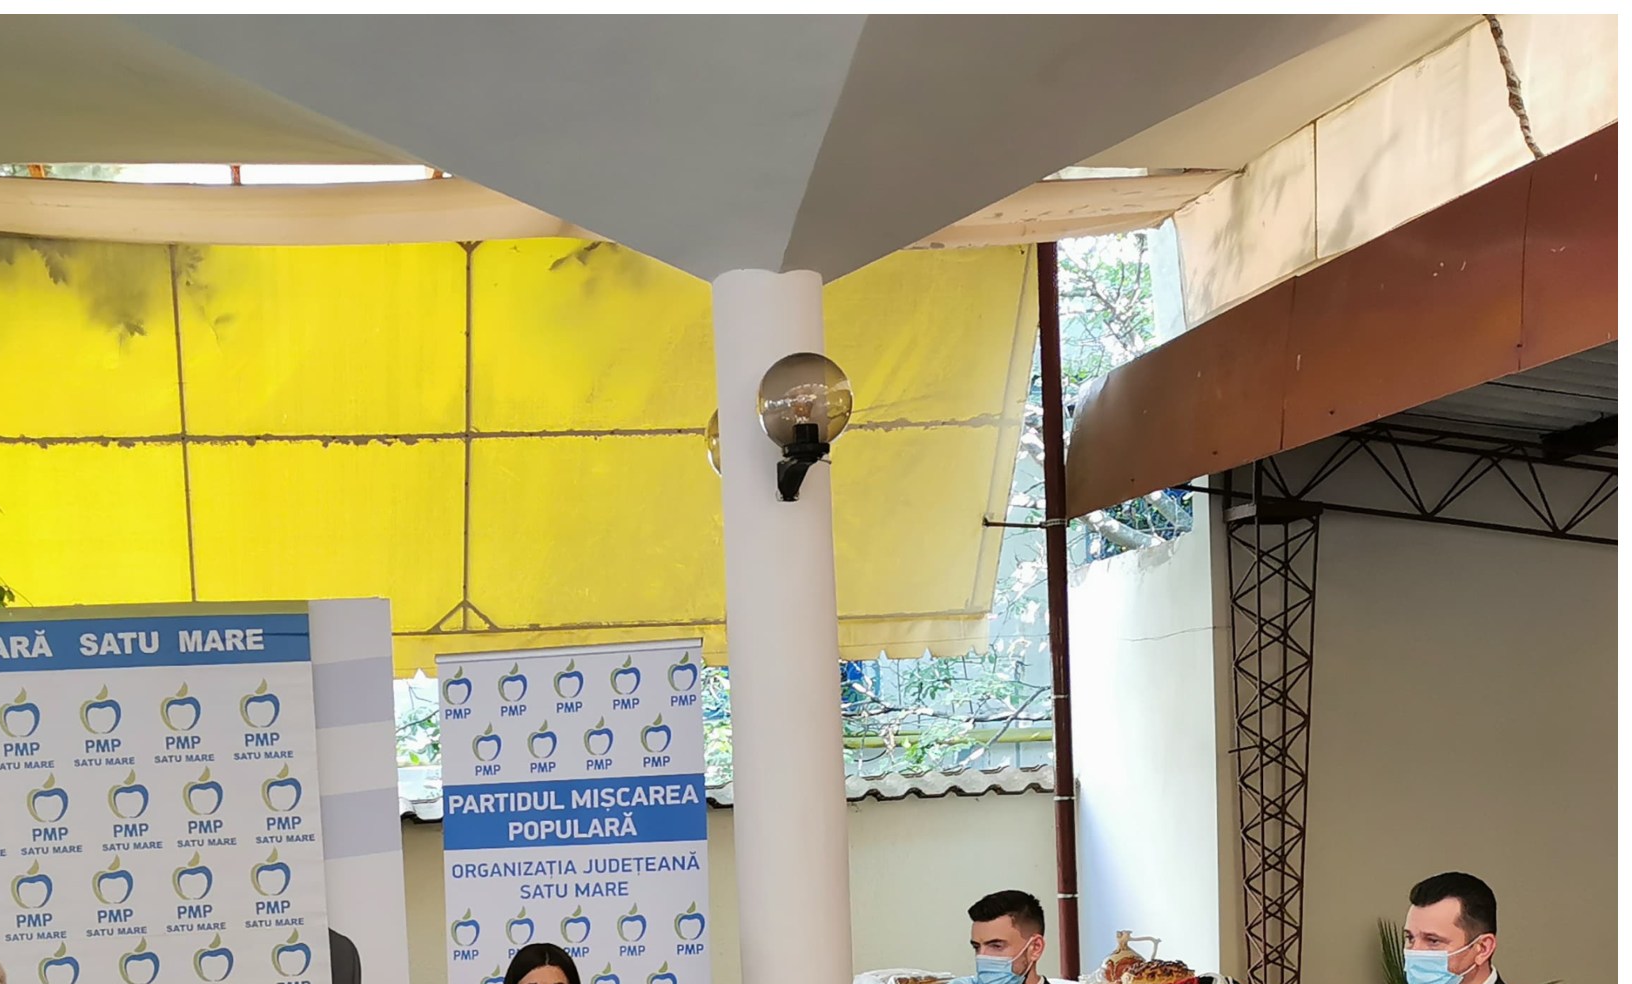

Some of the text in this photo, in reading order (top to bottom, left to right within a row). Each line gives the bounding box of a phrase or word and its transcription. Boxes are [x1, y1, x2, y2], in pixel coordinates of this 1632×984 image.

[79, 631, 159, 656] SATU
[179, 628, 265, 653] MARE
[612, 697, 640, 711] PMP
[670, 694, 697, 707] PMP
[444, 707, 472, 720] PMP
[500, 704, 527, 717] PMP
[556, 701, 583, 714] PMP
[85, 738, 122, 754] PMP
[165, 735, 202, 751] PMP
[244, 731, 281, 748] PMP
[3, 741, 41, 758] PMP
[233, 750, 294, 761] SATU MARE
[23, 759, 55, 769] MARE
[73, 756, 136, 768] SATU MARE
[154, 753, 215, 764] SATU MARE
[586, 758, 613, 771] PMP
[643, 755, 671, 768] PMP
[474, 764, 502, 777] PMP
[529, 761, 557, 774] PMP
[449, 785, 699, 814] PARTIDUL MIȘCAREA
[187, 819, 224, 835] PMP
[266, 815, 302, 831] PMP
[509, 812, 637, 841] POPULARĂ
[31, 826, 69, 843] PMP
[113, 822, 149, 838] PMP
[176, 837, 238, 848] SATU MARE
[255, 833, 316, 845] SATU MARE
[20, 844, 83, 856] SATU MARE
[102, 840, 164, 852] SATU MARE
[452, 851, 700, 878] ORGANIZAȚIA JUDEȚEANĂ
[520, 880, 629, 900] SATU MARE
[177, 904, 213, 920] PMP
[255, 899, 291, 915] PMP
[16, 912, 53, 929] PMP
[97, 908, 134, 924] PMP
[166, 921, 227, 933] SATU MARE
[244, 917, 305, 929] SATU MARE
[4, 930, 67, 942] SATU MARE
[85, 925, 148, 938] SATU MARE
[453, 949, 480, 961] PMP
[619, 944, 646, 957] PMP
[676, 943, 705, 956] PMP
